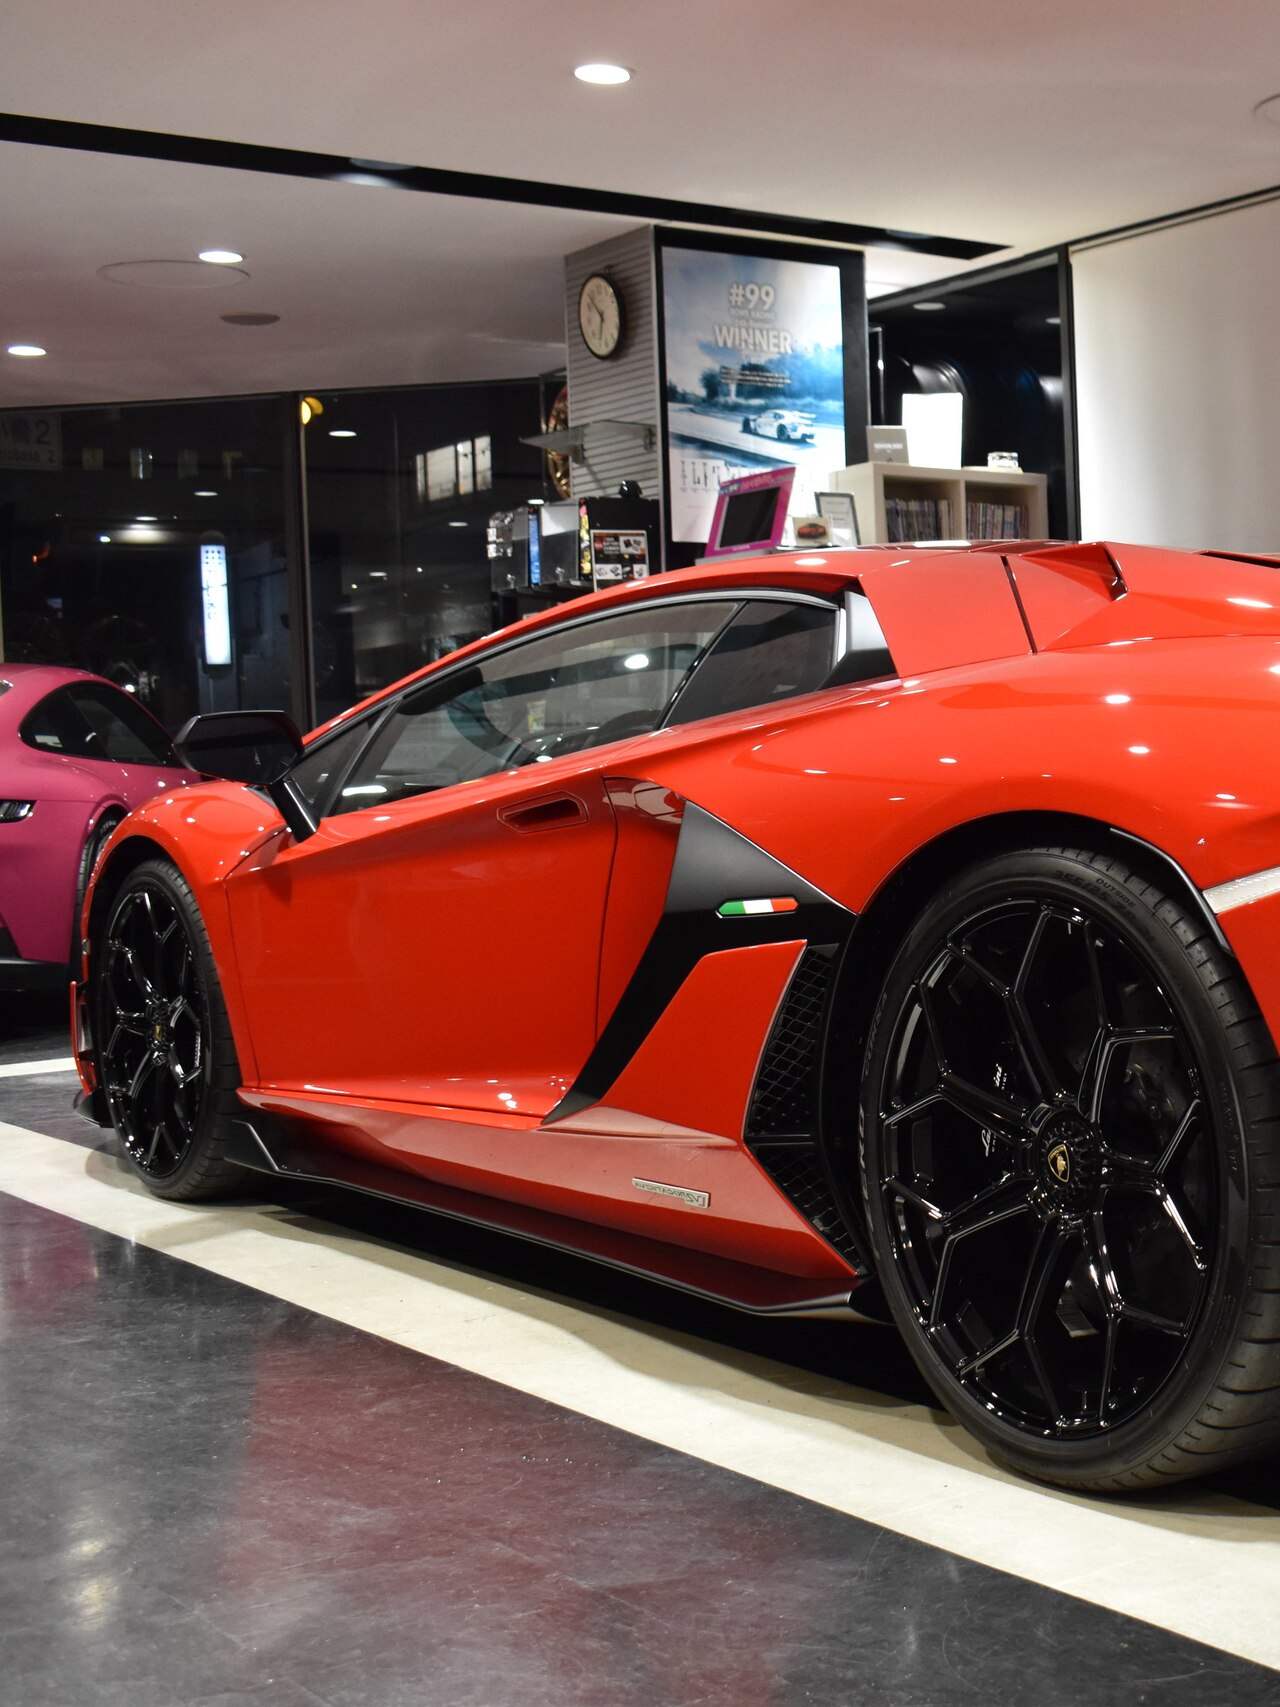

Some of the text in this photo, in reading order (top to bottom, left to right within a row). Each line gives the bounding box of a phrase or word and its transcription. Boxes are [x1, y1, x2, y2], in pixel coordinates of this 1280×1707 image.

[729, 283, 776, 311] #99
[714, 325, 793, 355] WINNER
[1096, 878, 1137, 909] OUTSIDE
